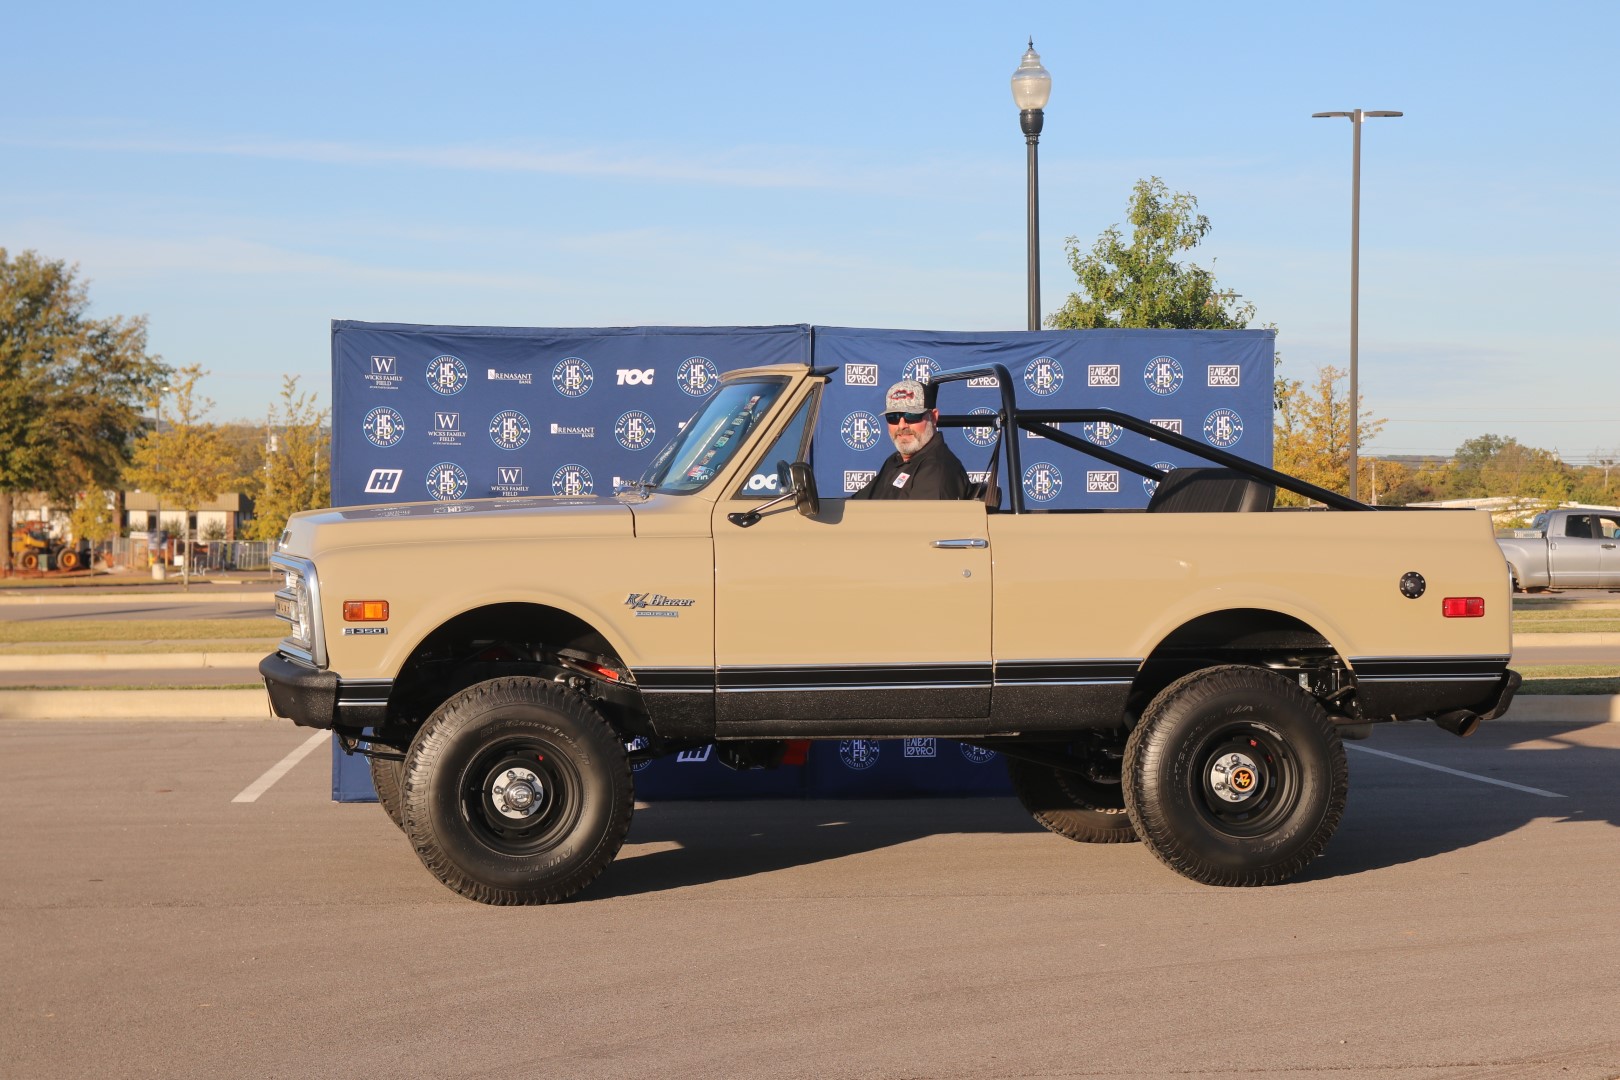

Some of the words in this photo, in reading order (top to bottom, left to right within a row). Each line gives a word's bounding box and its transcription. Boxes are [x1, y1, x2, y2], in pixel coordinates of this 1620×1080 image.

[373, 357, 393, 372] W
[440, 364, 453, 375] HC
[566, 366, 579, 377] HC
[691, 365, 704, 376] HC
[852, 366, 876, 376] NEXT
[916, 365, 929, 376] HC
[1037, 365, 1050, 376] HC
[1096, 367, 1118, 376] NEXT
[1157, 365, 1170, 376] HC
[1215, 367, 1238, 376] NEXT
[440, 375, 454, 387] FC
[616, 369, 655, 385] TOC
[856, 376, 876, 384] PRO
[979, 377, 998, 386] PRO
[1037, 377, 1050, 388] FC
[1099, 376, 1118, 385] PRO
[1157, 376, 1170, 388] FC
[1219, 376, 1238, 385] PRO
[566, 377, 579, 389] FC
[691, 377, 704, 389] FC
[377, 415, 390, 427] HC
[437, 414, 457, 428] W
[503, 419, 516, 430] HC
[629, 419, 642, 430] HC
[854, 419, 867, 431] HC
[1217, 417, 1230, 428] HC
[377, 427, 391, 439] FC
[503, 430, 517, 442] FC
[629, 430, 642, 442] FC
[854, 431, 867, 443] FC
[1097, 427, 1110, 439] FC
[1217, 428, 1230, 440] FC
[440, 471, 454, 482] HC
[500, 469, 520, 483] W
[566, 473, 579, 484] HC
[851, 472, 874, 481] NEXT
[973, 473, 991, 482] NEX
[1036, 471, 1049, 482] HC
[1094, 472, 1117, 481] NEXT
[743, 474, 778, 490] OC
[1098, 482, 1117, 490] PRO
[440, 483, 454, 495] FC
[566, 484, 579, 495] FC
[1036, 482, 1049, 494] FC
[650, 594, 695, 606] Blazer
